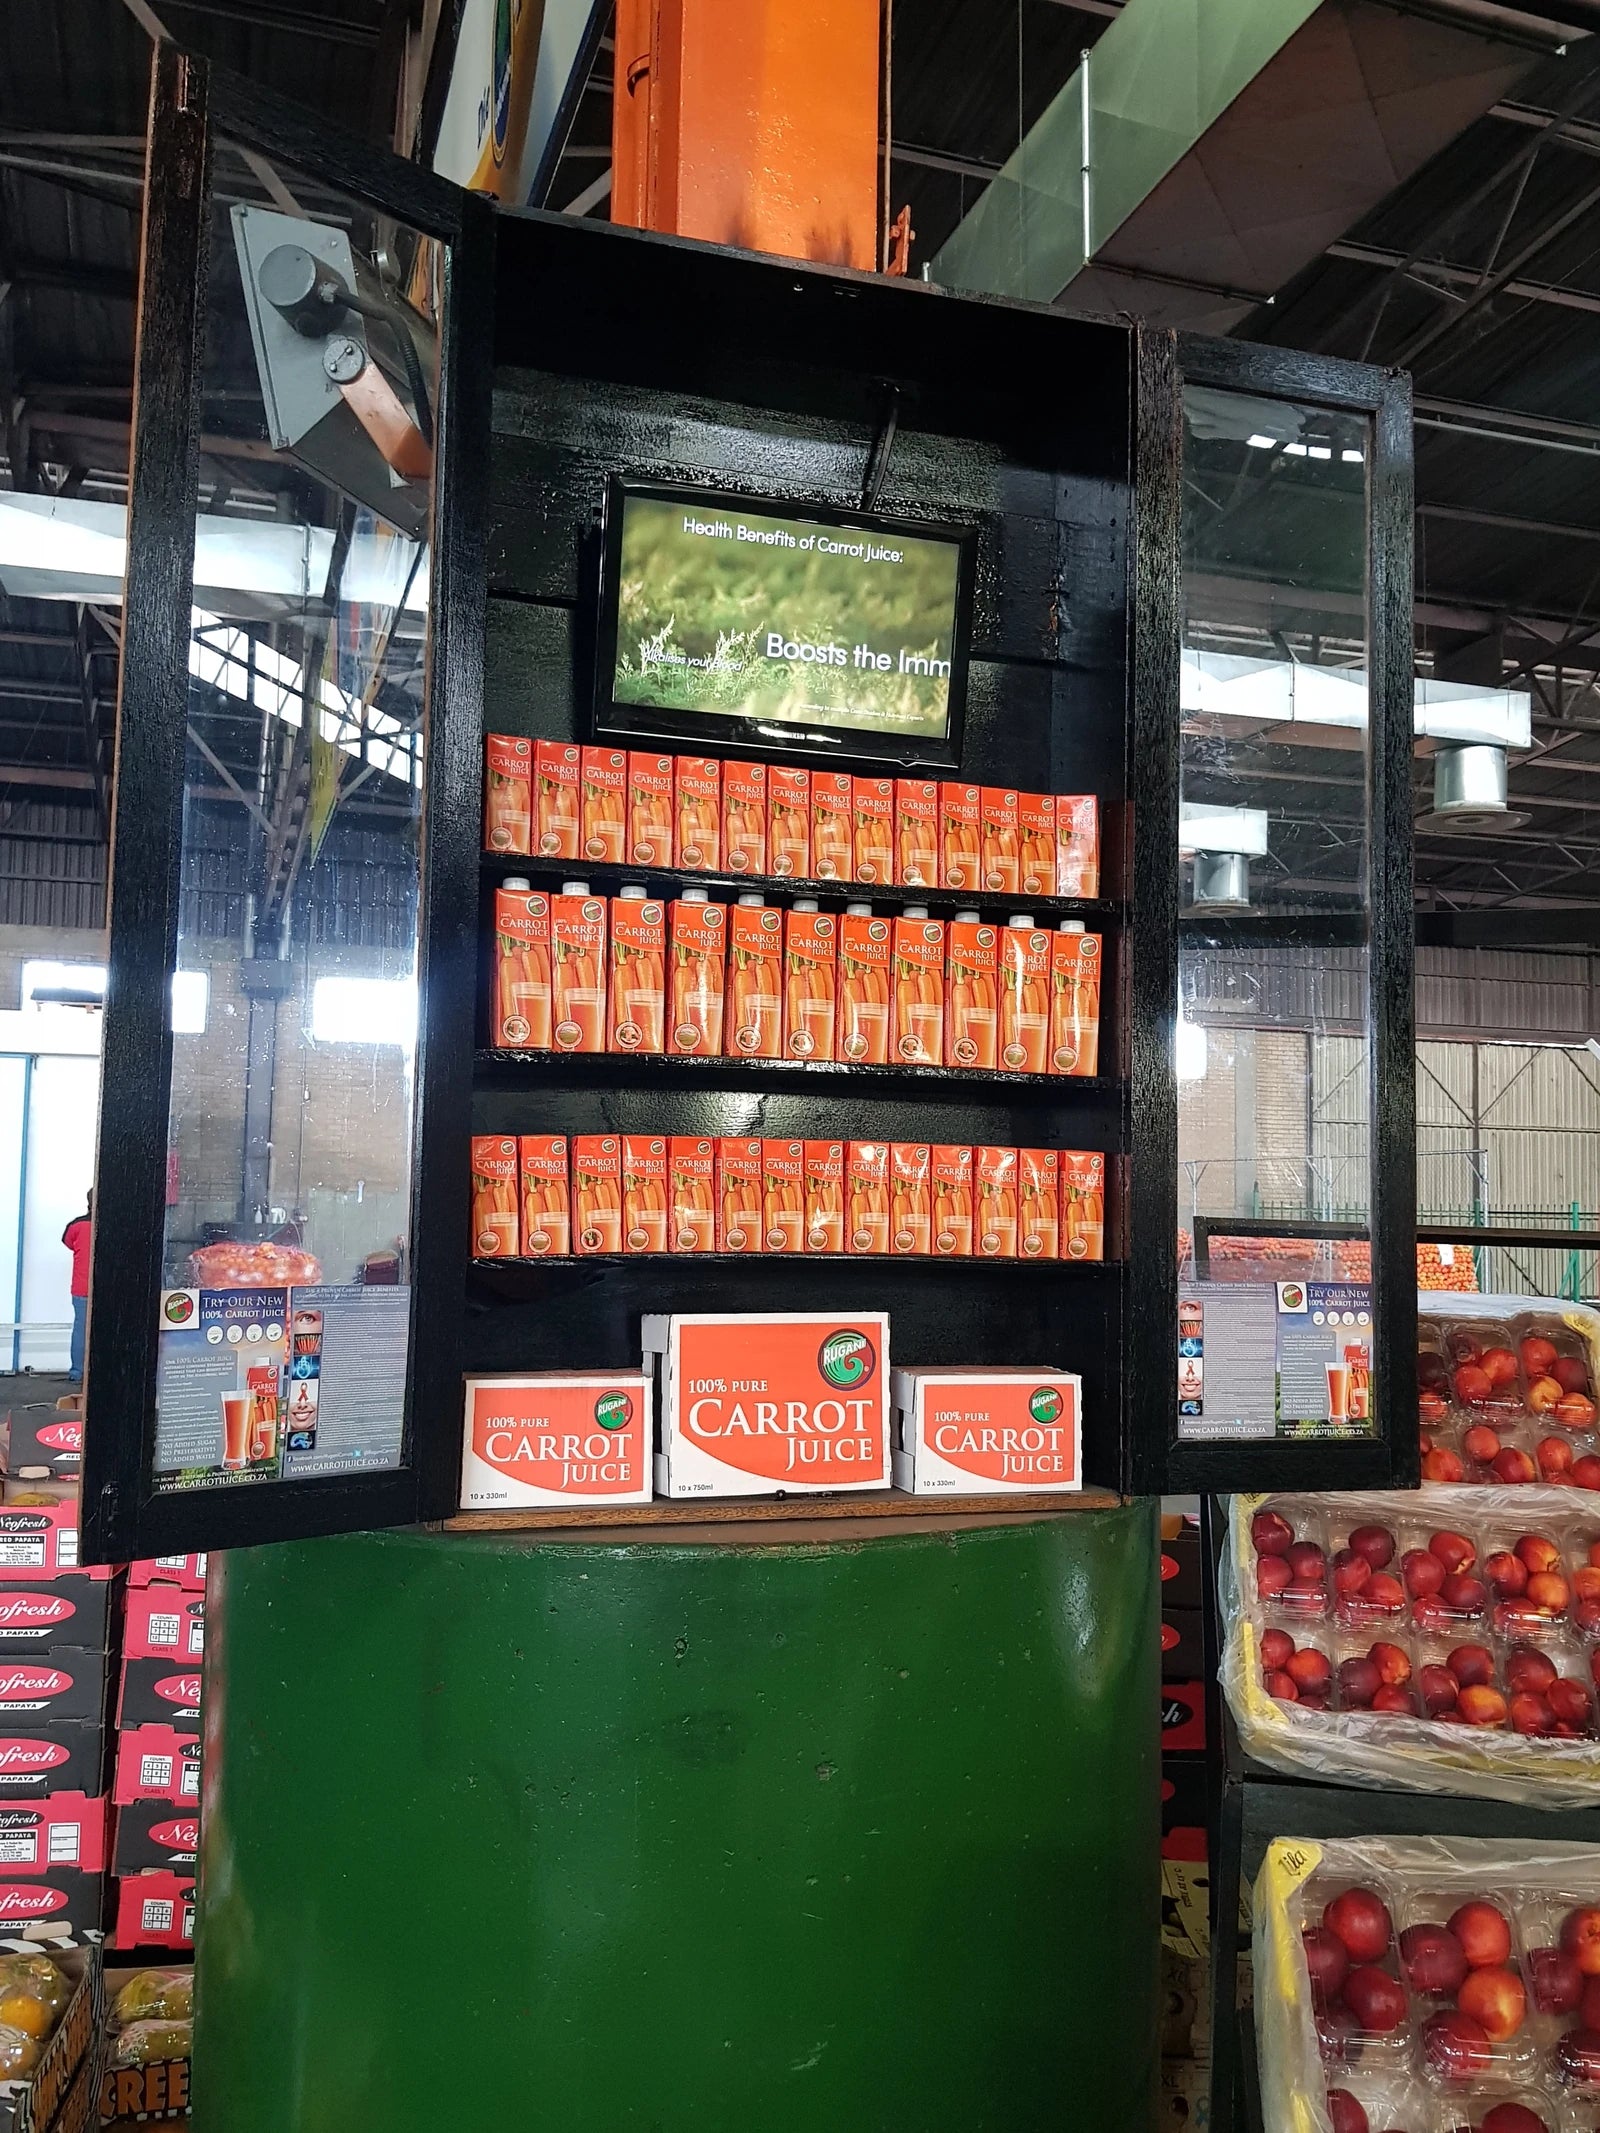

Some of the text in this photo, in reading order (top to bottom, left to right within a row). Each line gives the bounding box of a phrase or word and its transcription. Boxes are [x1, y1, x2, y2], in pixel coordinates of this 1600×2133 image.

[683, 516, 905, 564] Health Benefits of Carrot Juice:
[766, 632, 951, 678] Boosts the Imm
[491, 757, 530, 770] CARROT
[541, 763, 580, 775] CARROT
[586, 769, 624, 780] CARROT
[634, 774, 672, 786] CARROT
[682, 778, 719, 790] CARROT
[728, 783, 765, 794] CARROT
[773, 788, 808, 799] CARROT
[816, 793, 851, 804] CARROT
[856, 798, 891, 809] CARROT
[901, 800, 936, 812] CARROT
[946, 804, 978, 815] CARROT
[985, 808, 1017, 819] CARROT
[1022, 814, 1054, 824] CARROT
[500, 918, 548, 930] CARROT
[525, 928, 548, 936] JUICE
[556, 924, 603, 936] CARROT
[616, 926, 662, 938] CARROT
[676, 928, 723, 940] CARROT
[639, 936, 662, 945] JUICE
[700, 939, 722, 948] JUICE
[736, 932, 780, 944] CARROT
[759, 942, 780, 950] JUICE
[790, 938, 834, 950] CARROT
[845, 942, 888, 953] CARROT
[900, 944, 942, 955] CARROT
[812, 948, 834, 956] JUICE
[866, 952, 887, 960] JUICE
[922, 953, 942, 962] JUICE
[954, 948, 995, 960] CARROT
[975, 958, 995, 966] JUICE
[1056, 958, 1098, 968] CARROT
[1027, 964, 1048, 972] JUICE
[476, 1160, 516, 1170] CARROT
[527, 1160, 567, 1170] CARROT
[578, 1158, 617, 1168] CARROT
[627, 1158, 665, 1168] CARROT
[676, 1159, 712, 1168] CARROT
[726, 1160, 761, 1169] CARROT
[766, 1161, 802, 1170] CARROT
[808, 1162, 842, 1172] CARROT
[853, 1162, 888, 1172] CARROT
[936, 1166, 971, 1176] CARROT
[1069, 1172, 1103, 1182] CARROT
[1310, 1288, 1369, 1298] TRY OUR NEW
[202, 1297, 225, 1308] TRY
[228, 1296, 254, 1308] OUR
[256, 1295, 284, 1306] NEW
[202, 1308, 285, 1320] 100% CARROT JUICE
[823, 1338, 867, 1367] RUGANI
[688, 1379, 768, 1394] 100% PURE
[486, 1416, 550, 1428] 100% PURE
[688, 1398, 873, 1438] CARROT
[934, 1411, 990, 1422] 100% PURE
[935, 1425, 1064, 1453] CARROT
[485, 1432, 633, 1462] CARROT
[785, 1437, 873, 1472] JUICE
[1001, 1453, 1064, 1478] JUICE
[560, 1462, 631, 1489] JUICE
[486, 1492, 508, 1500] 330ml
